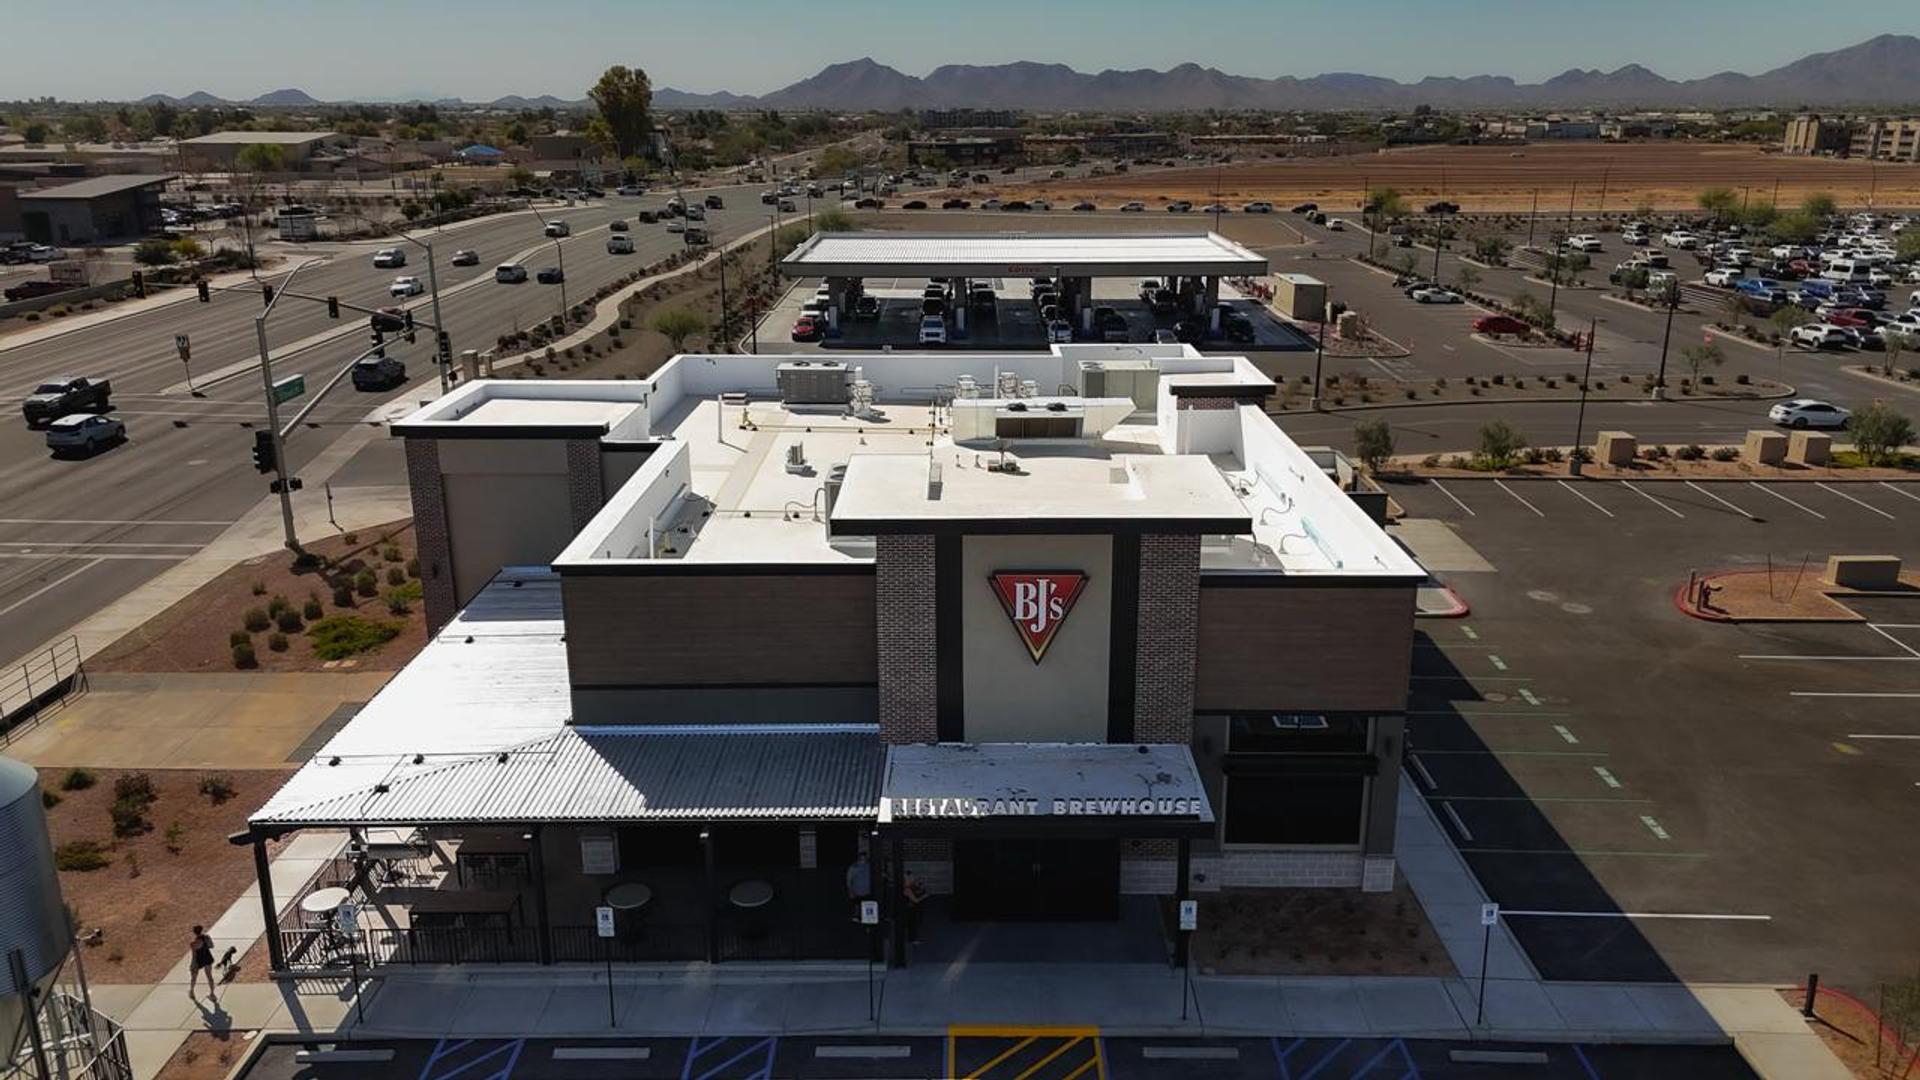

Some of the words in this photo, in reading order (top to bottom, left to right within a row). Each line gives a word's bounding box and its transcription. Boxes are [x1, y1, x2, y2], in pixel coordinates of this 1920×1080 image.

[1013, 578, 1064, 633] BJ's
[891, 798, 1039, 816] RESTAURANT
[1052, 799, 1201, 815] BREWHOUSE
